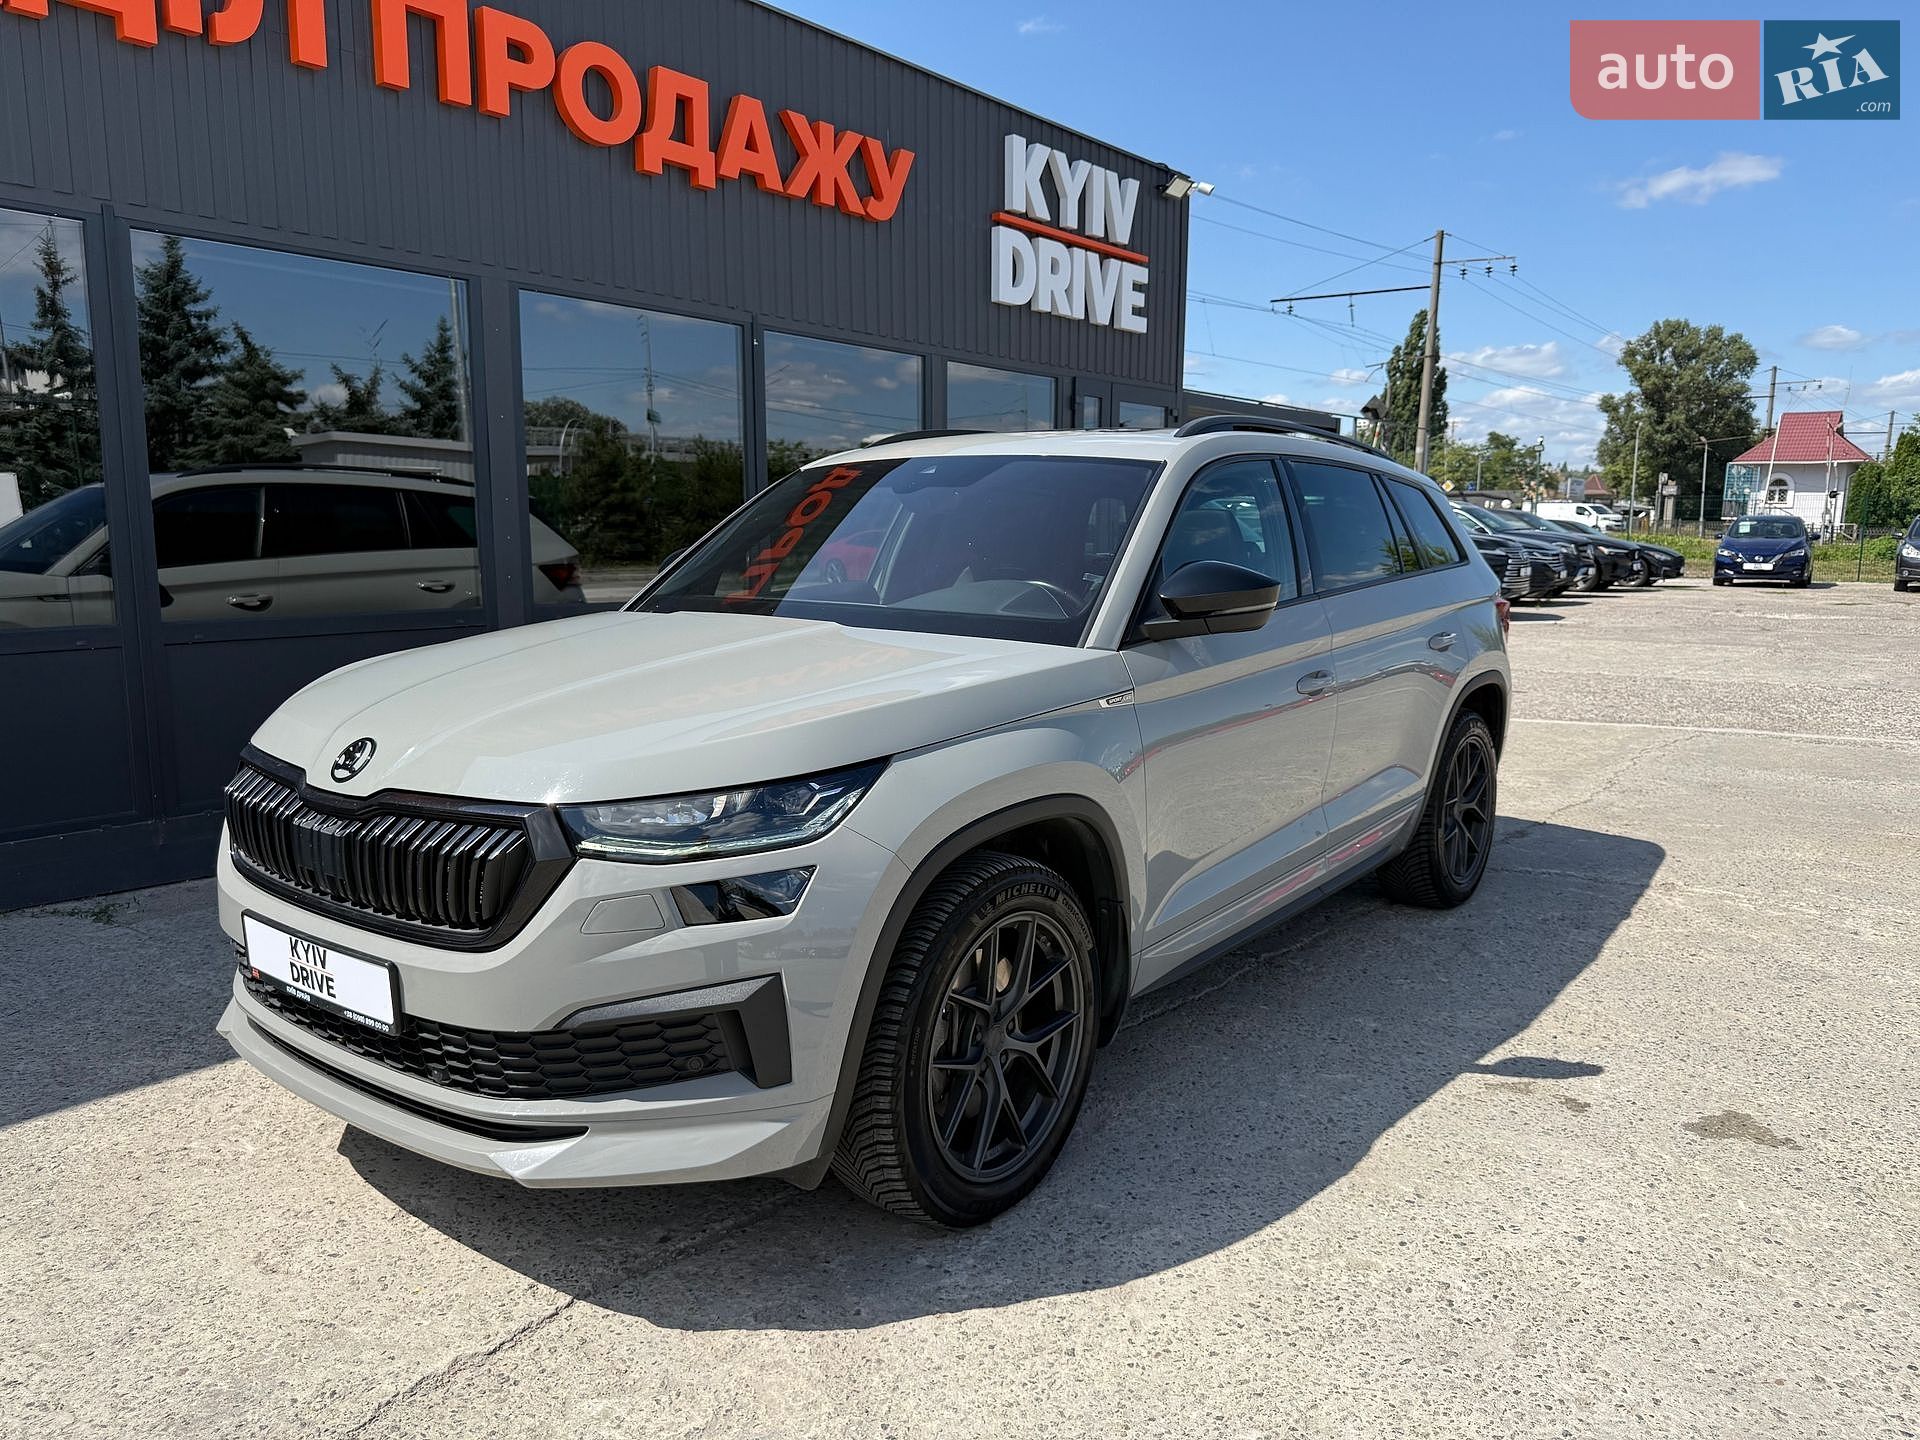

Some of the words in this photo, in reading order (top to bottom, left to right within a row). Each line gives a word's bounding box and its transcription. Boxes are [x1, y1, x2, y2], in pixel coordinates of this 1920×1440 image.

[372, 0, 915, 223] ПРОДАЖУ
[1004, 134, 1140, 245] KYIV
[991, 226, 1149, 333] DRIVE
[996, 883, 1057, 905] MICHELIN
[289, 937, 327, 969] KYIV
[289, 961, 336, 998] DRIVE
